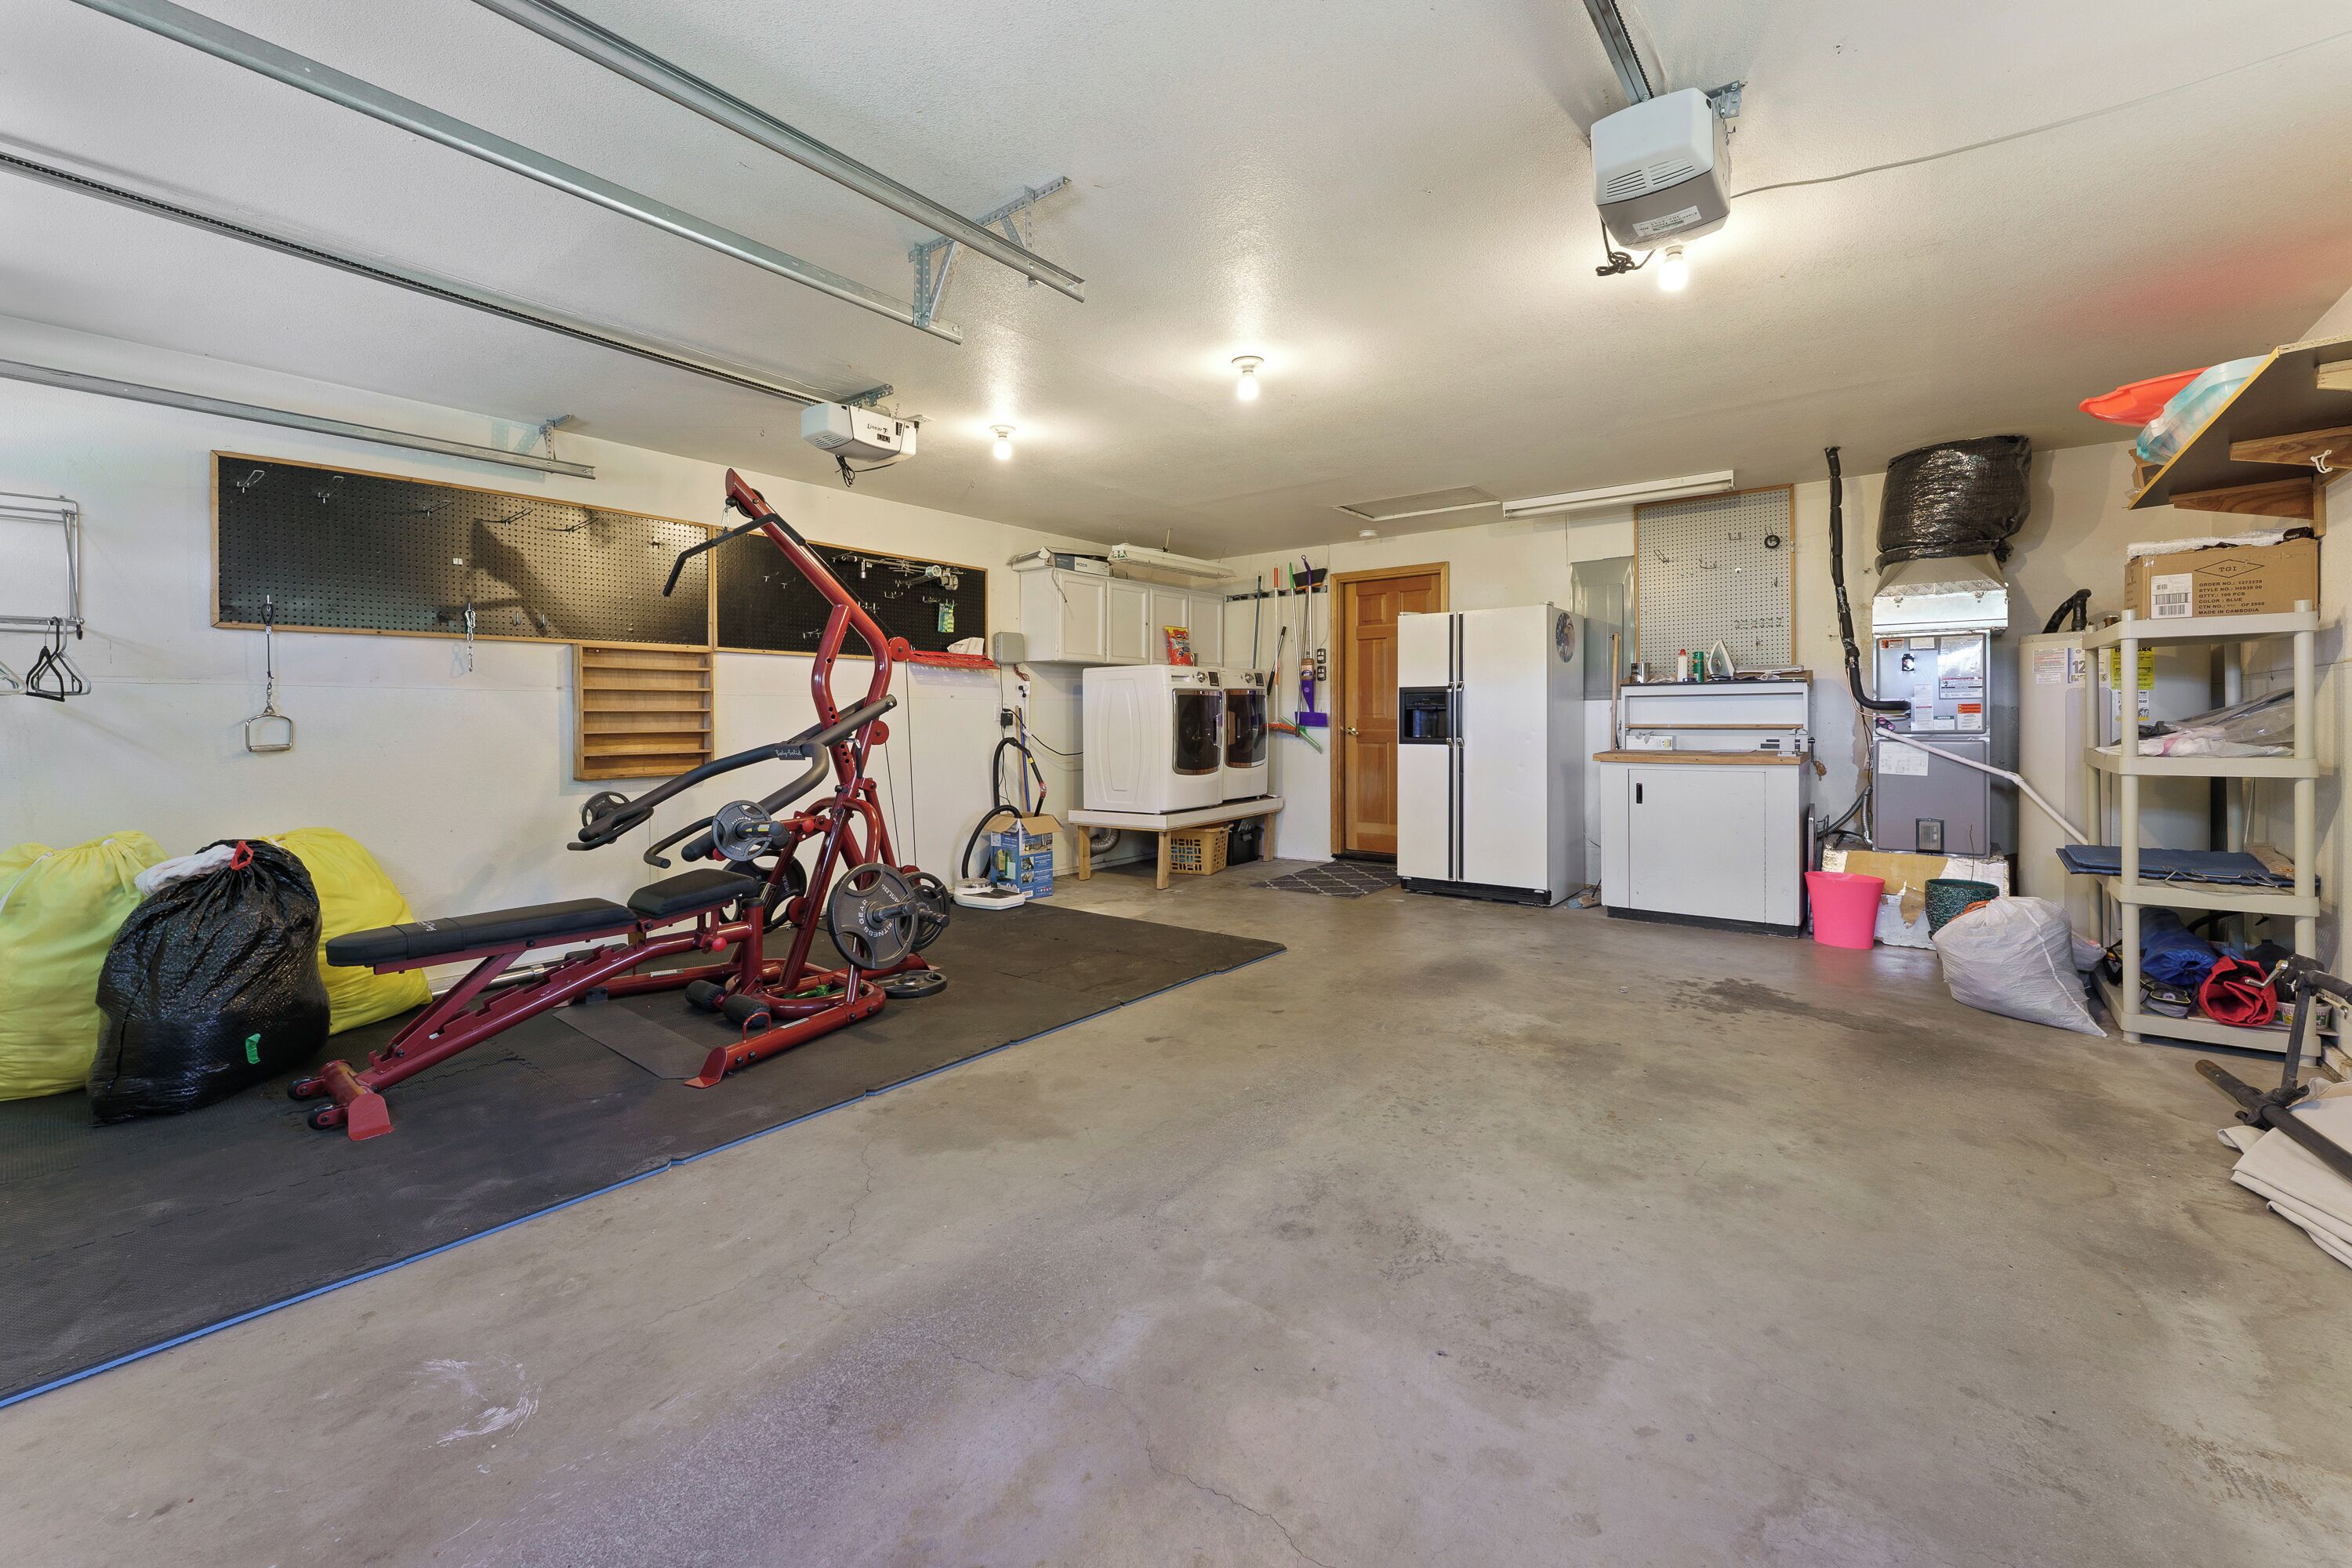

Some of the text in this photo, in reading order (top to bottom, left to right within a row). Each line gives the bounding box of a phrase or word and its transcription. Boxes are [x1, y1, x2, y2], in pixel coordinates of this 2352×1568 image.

[867, 423, 883, 432] Linear
[858, 898, 892, 938] FITNESS GEAR
